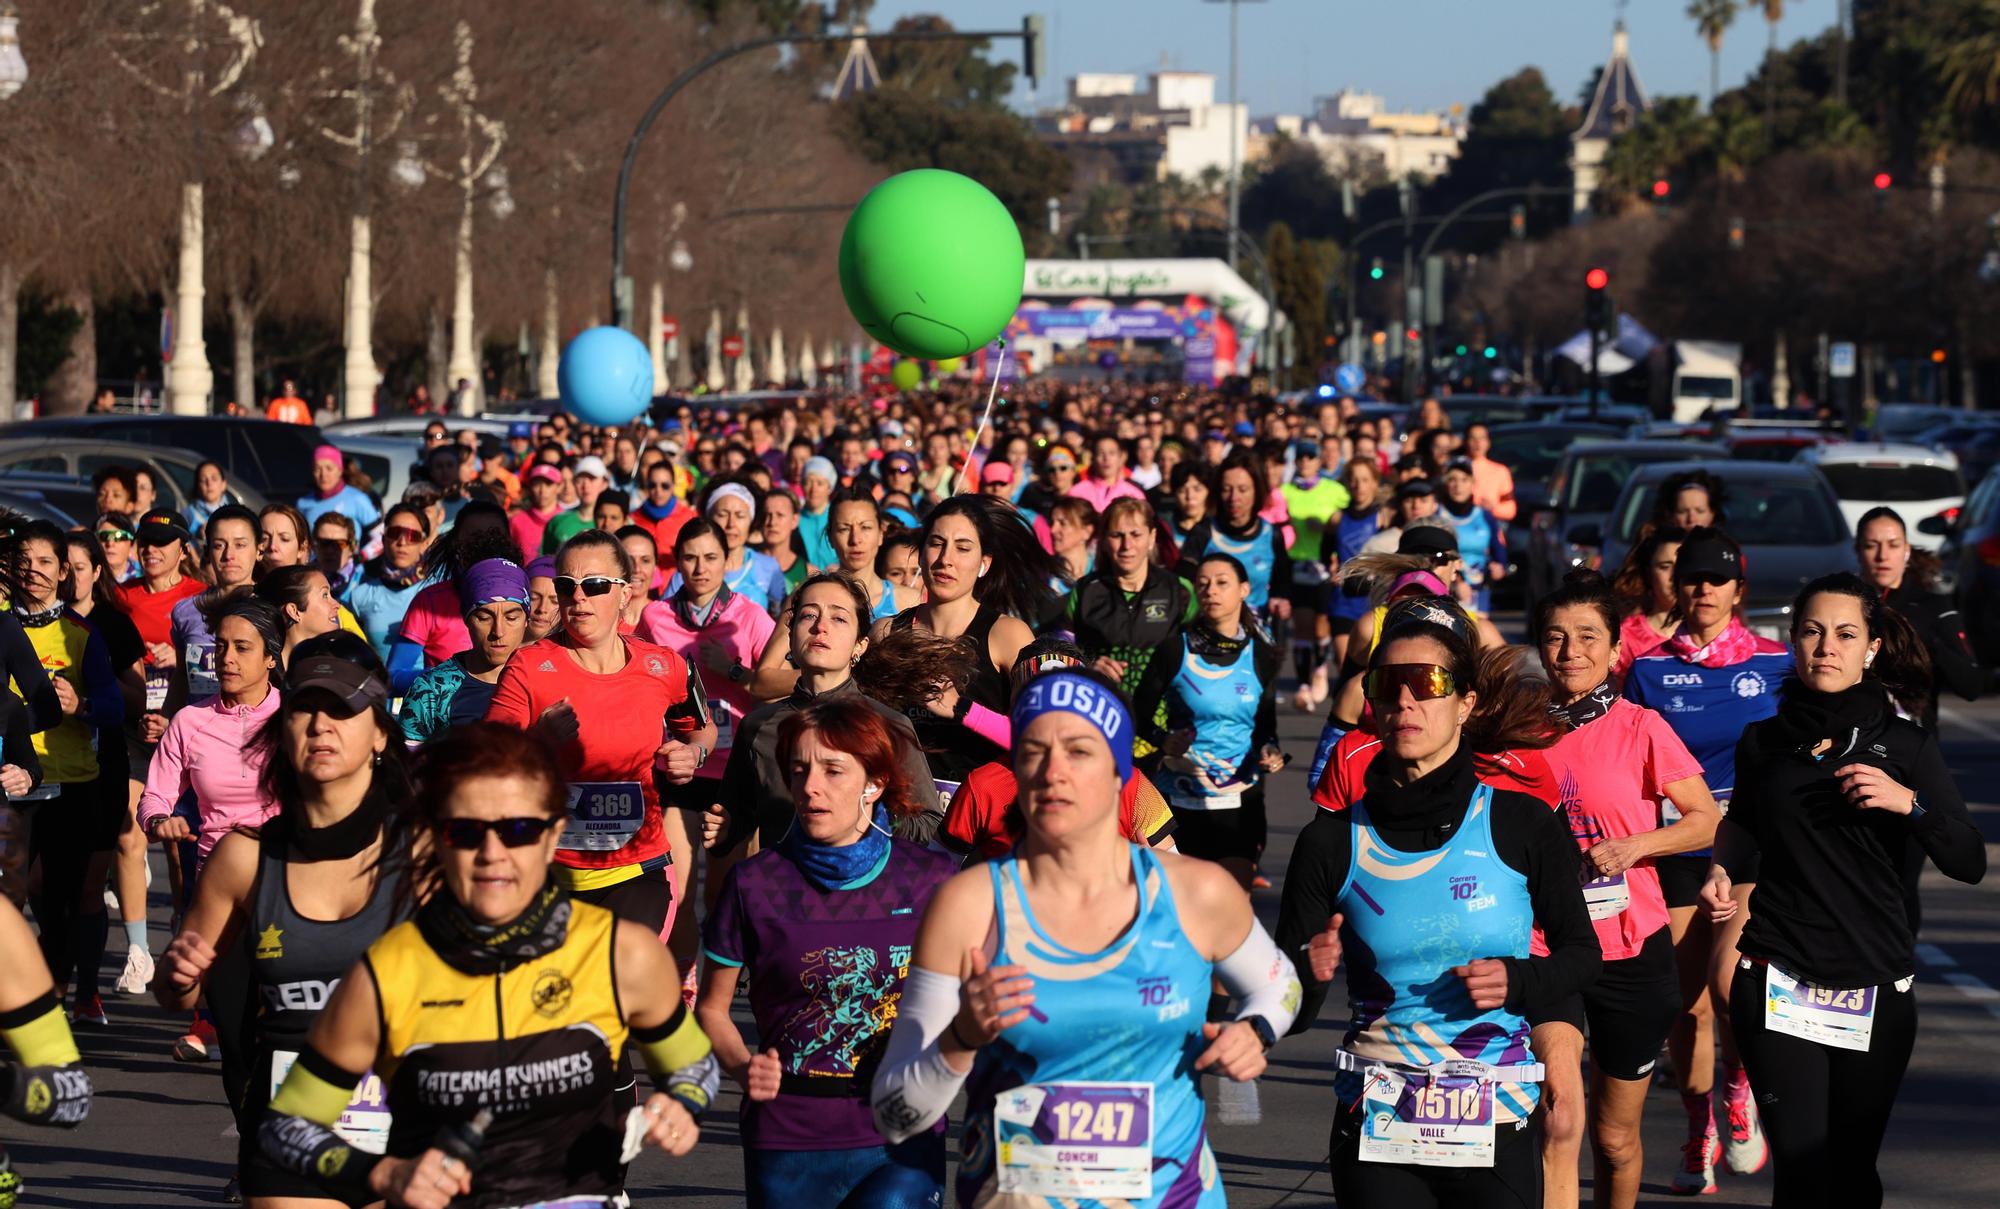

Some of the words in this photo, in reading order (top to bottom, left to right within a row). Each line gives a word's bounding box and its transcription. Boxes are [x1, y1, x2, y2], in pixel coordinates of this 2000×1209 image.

[591, 793, 632, 817] 369
[585, 822, 622, 831] ALEXANDRA
[1449, 875, 1477, 884] Carrera
[1468, 894, 1498, 912] FEM
[1807, 983, 1866, 1011] 1923
[418, 1068, 501, 1092] PATERNA
[504, 1050, 593, 1087] RUNNERS
[477, 1071, 594, 1105] ATLETISMO
[1413, 1087, 1480, 1120] 1510
[1053, 1101, 1135, 1141] 1247
[1419, 1127, 1446, 1138] VALLE
[1057, 1151, 1098, 1163] CONCHI
